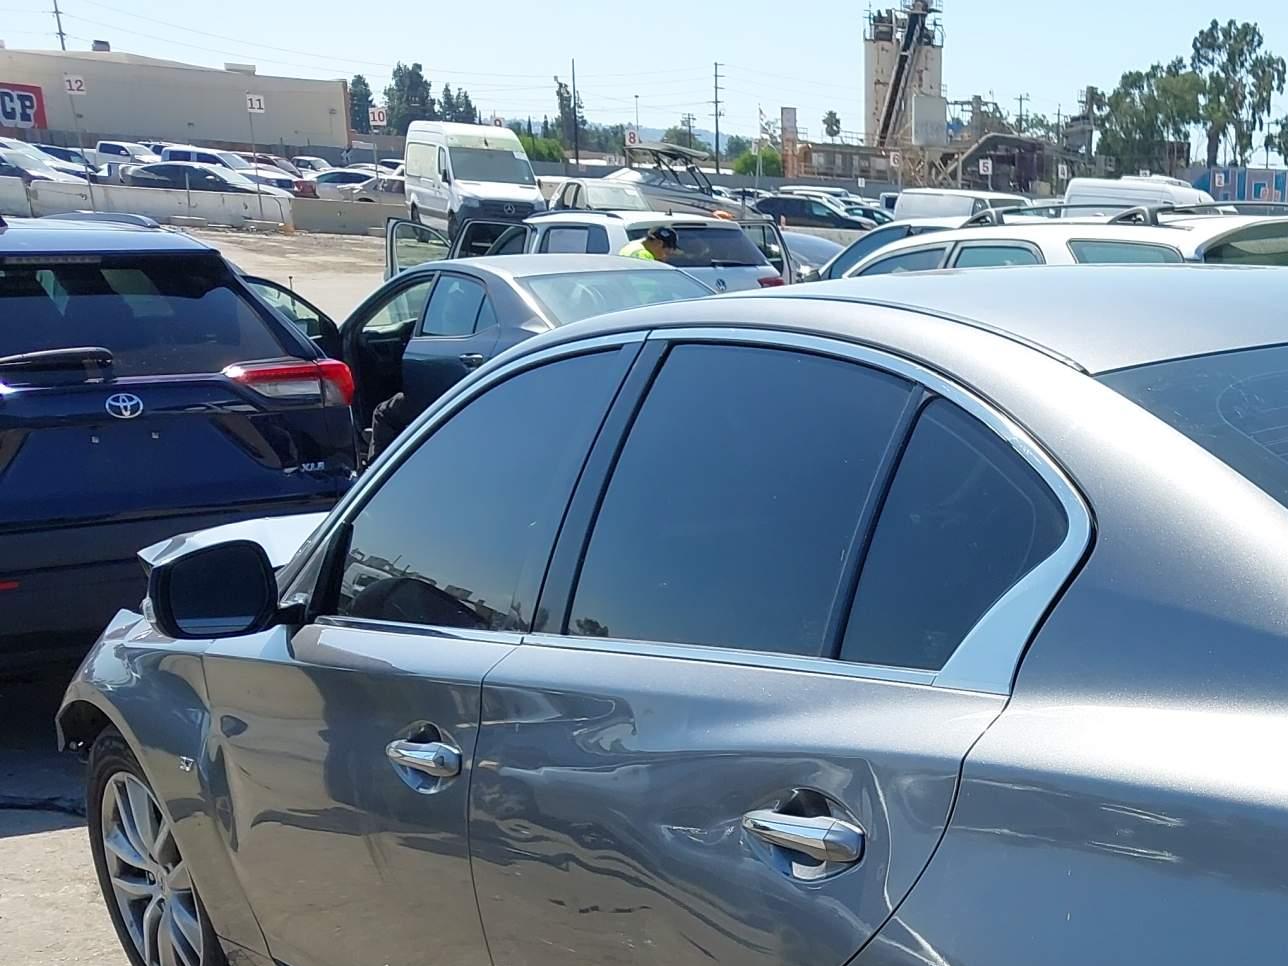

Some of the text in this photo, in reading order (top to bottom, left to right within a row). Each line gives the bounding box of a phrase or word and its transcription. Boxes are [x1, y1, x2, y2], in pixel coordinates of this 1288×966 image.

[66, 79, 85, 91] 12
[248, 98, 264, 110] 11
[370, 110, 385, 122] 10
[628, 131, 637, 144] 8
[893, 153, 900, 163] 6
[982, 161, 989, 173] 5
